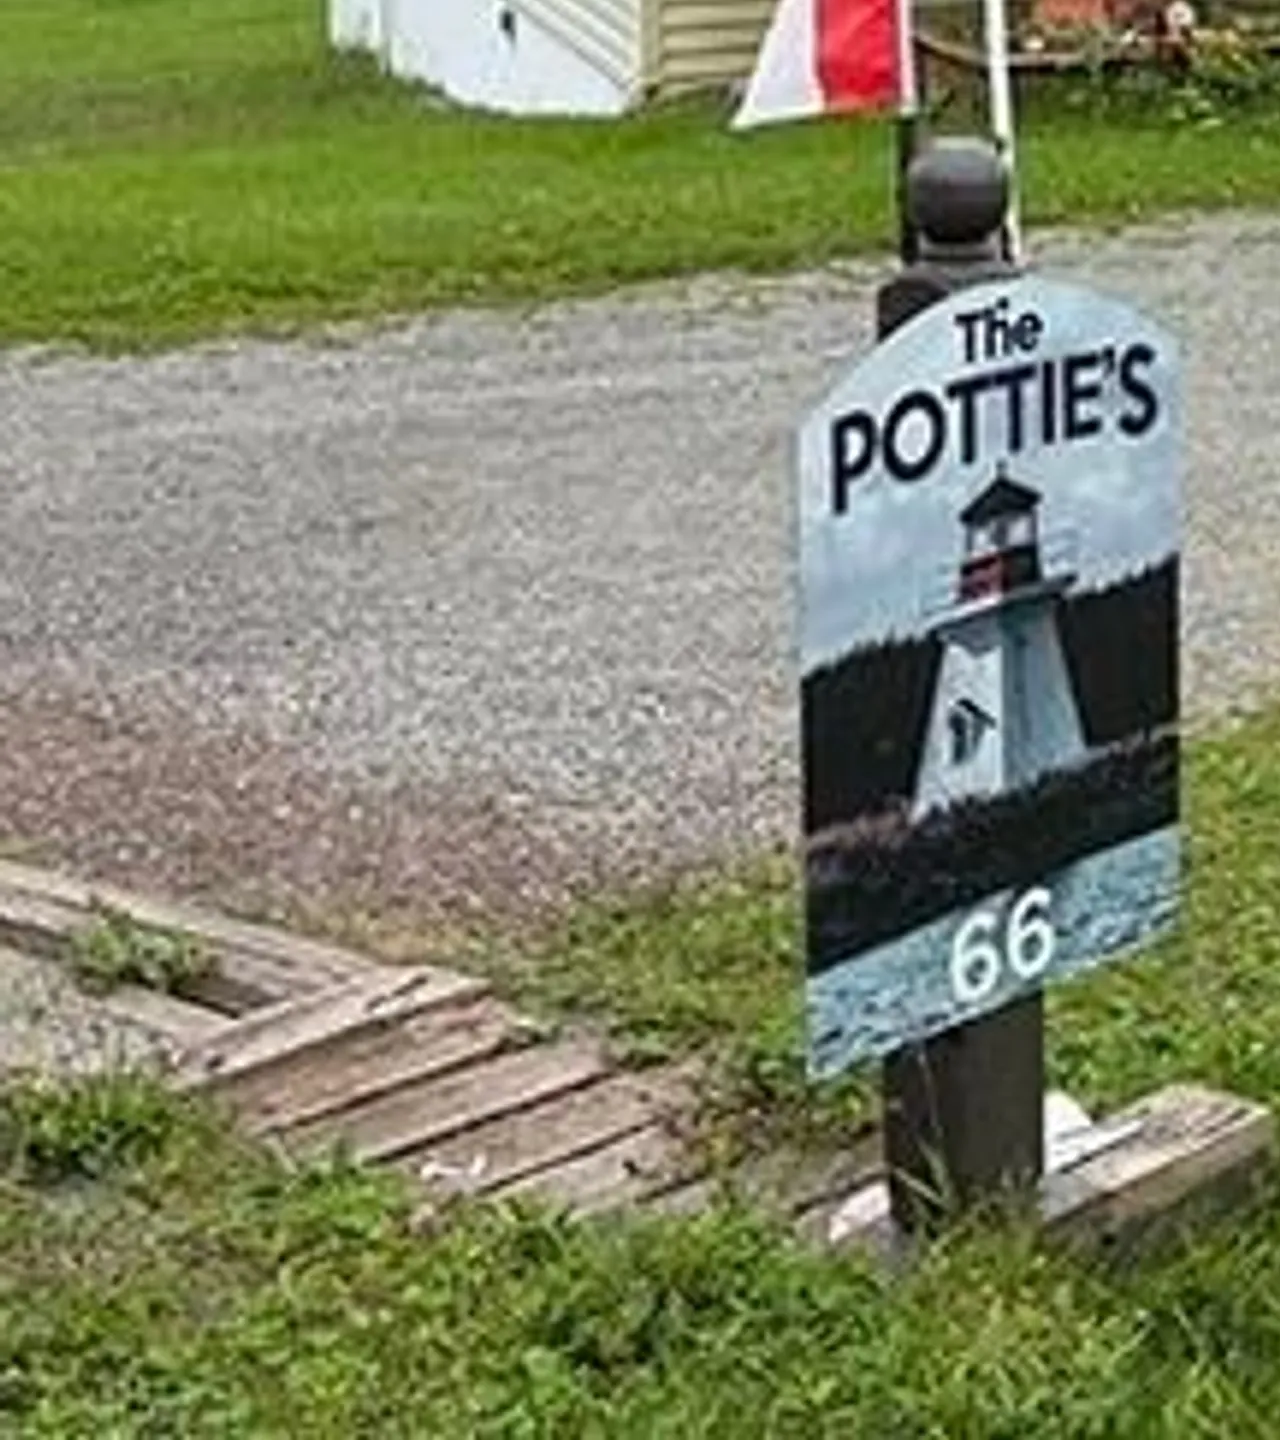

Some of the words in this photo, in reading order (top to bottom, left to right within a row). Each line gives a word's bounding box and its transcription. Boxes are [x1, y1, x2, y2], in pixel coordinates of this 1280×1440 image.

[955, 297, 1044, 362] The
[832, 343, 1159, 516] POTTIE'S
[952, 886, 1056, 1002] 66
